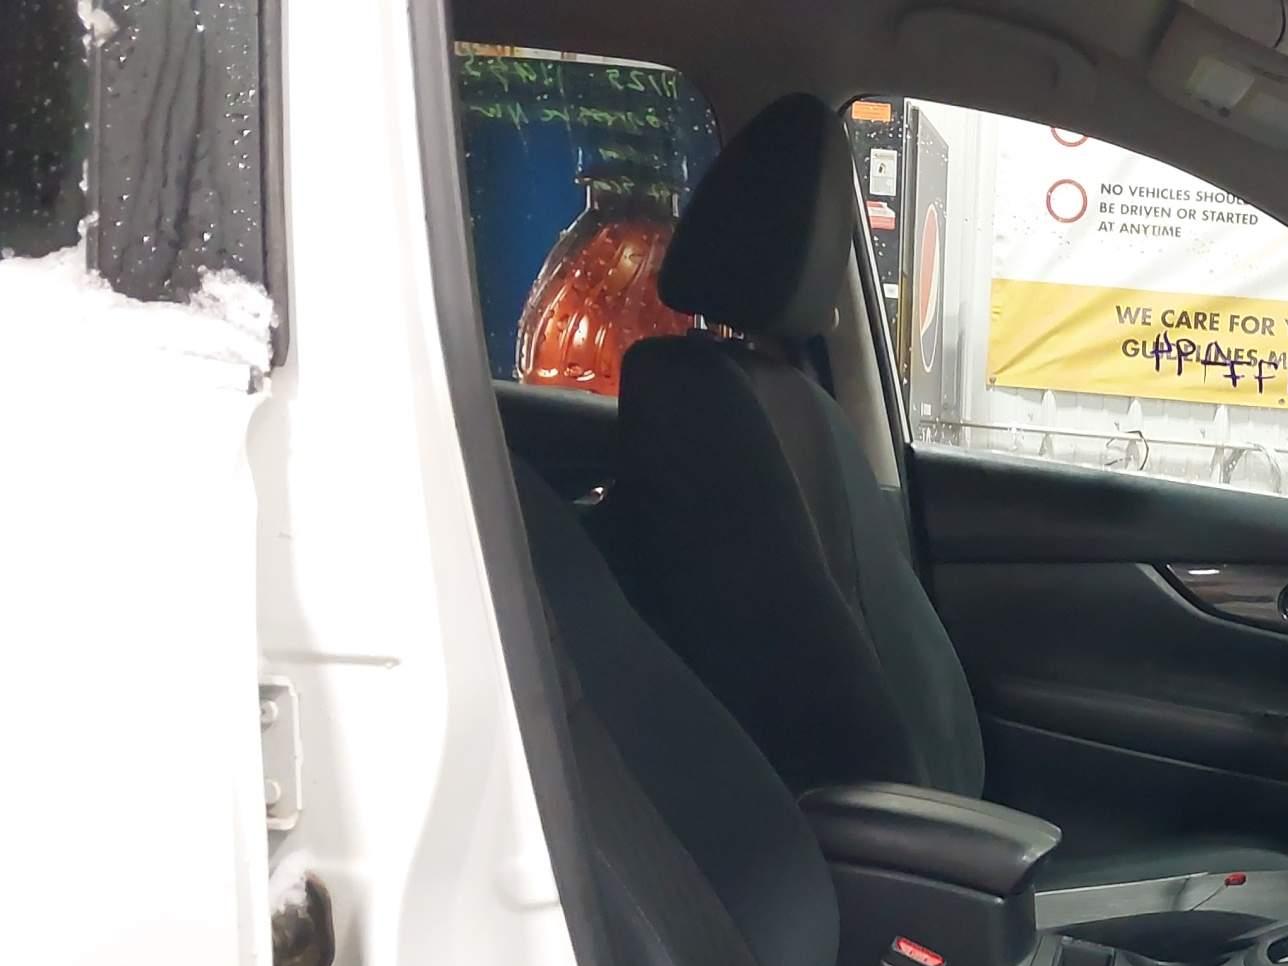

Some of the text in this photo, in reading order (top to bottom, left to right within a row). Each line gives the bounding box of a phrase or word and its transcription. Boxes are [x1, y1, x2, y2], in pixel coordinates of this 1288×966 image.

[1100, 183, 1124, 196] NO
[1128, 185, 1191, 201] VEHICLES
[1099, 202, 1258, 226] BE DRIVEN OR STARTED
[1098, 221, 1182, 238] AT ANYTIME
[1115, 305, 1153, 326] WE
[1160, 309, 1220, 332] CARE
[1229, 314, 1275, 337] FOR
